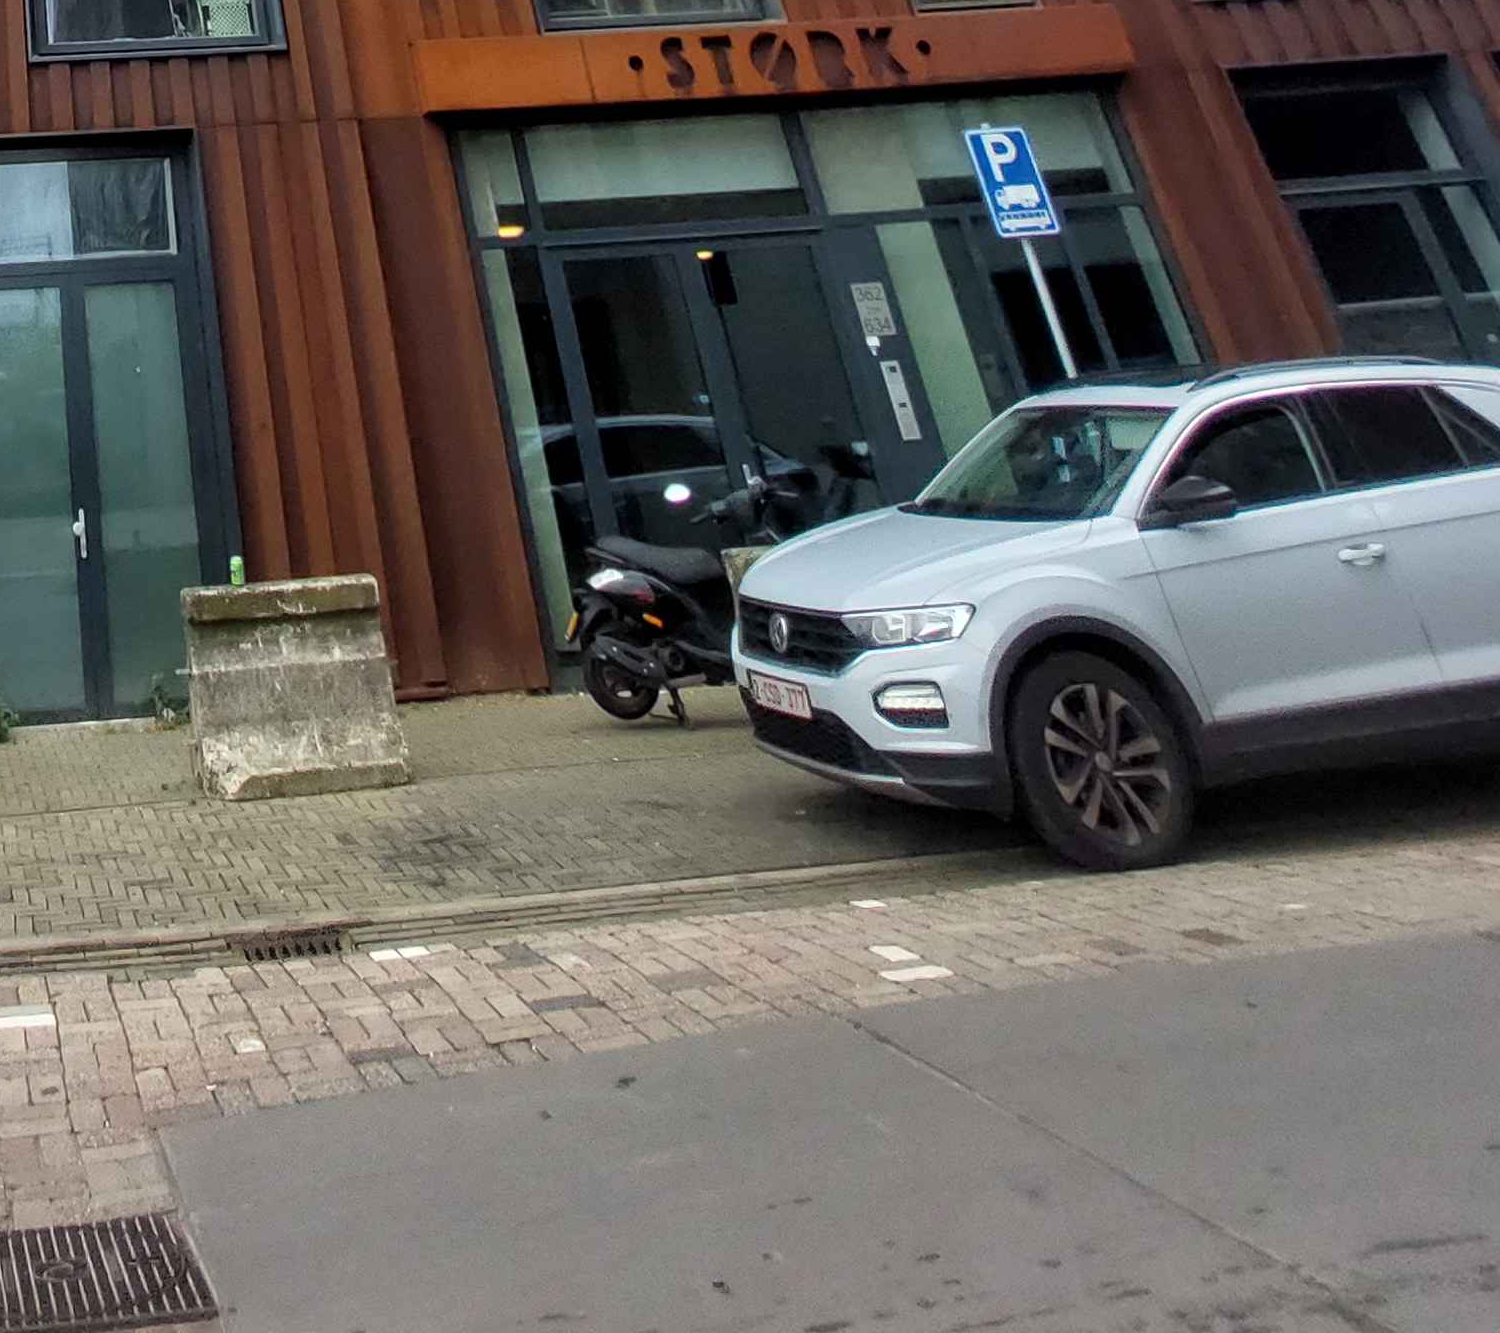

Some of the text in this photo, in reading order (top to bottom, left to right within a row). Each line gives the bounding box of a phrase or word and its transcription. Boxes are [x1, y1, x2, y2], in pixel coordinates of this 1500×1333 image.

[980, 133, 1017, 182] P
[854, 286, 885, 302] 362
[863, 316, 892, 333] 634
